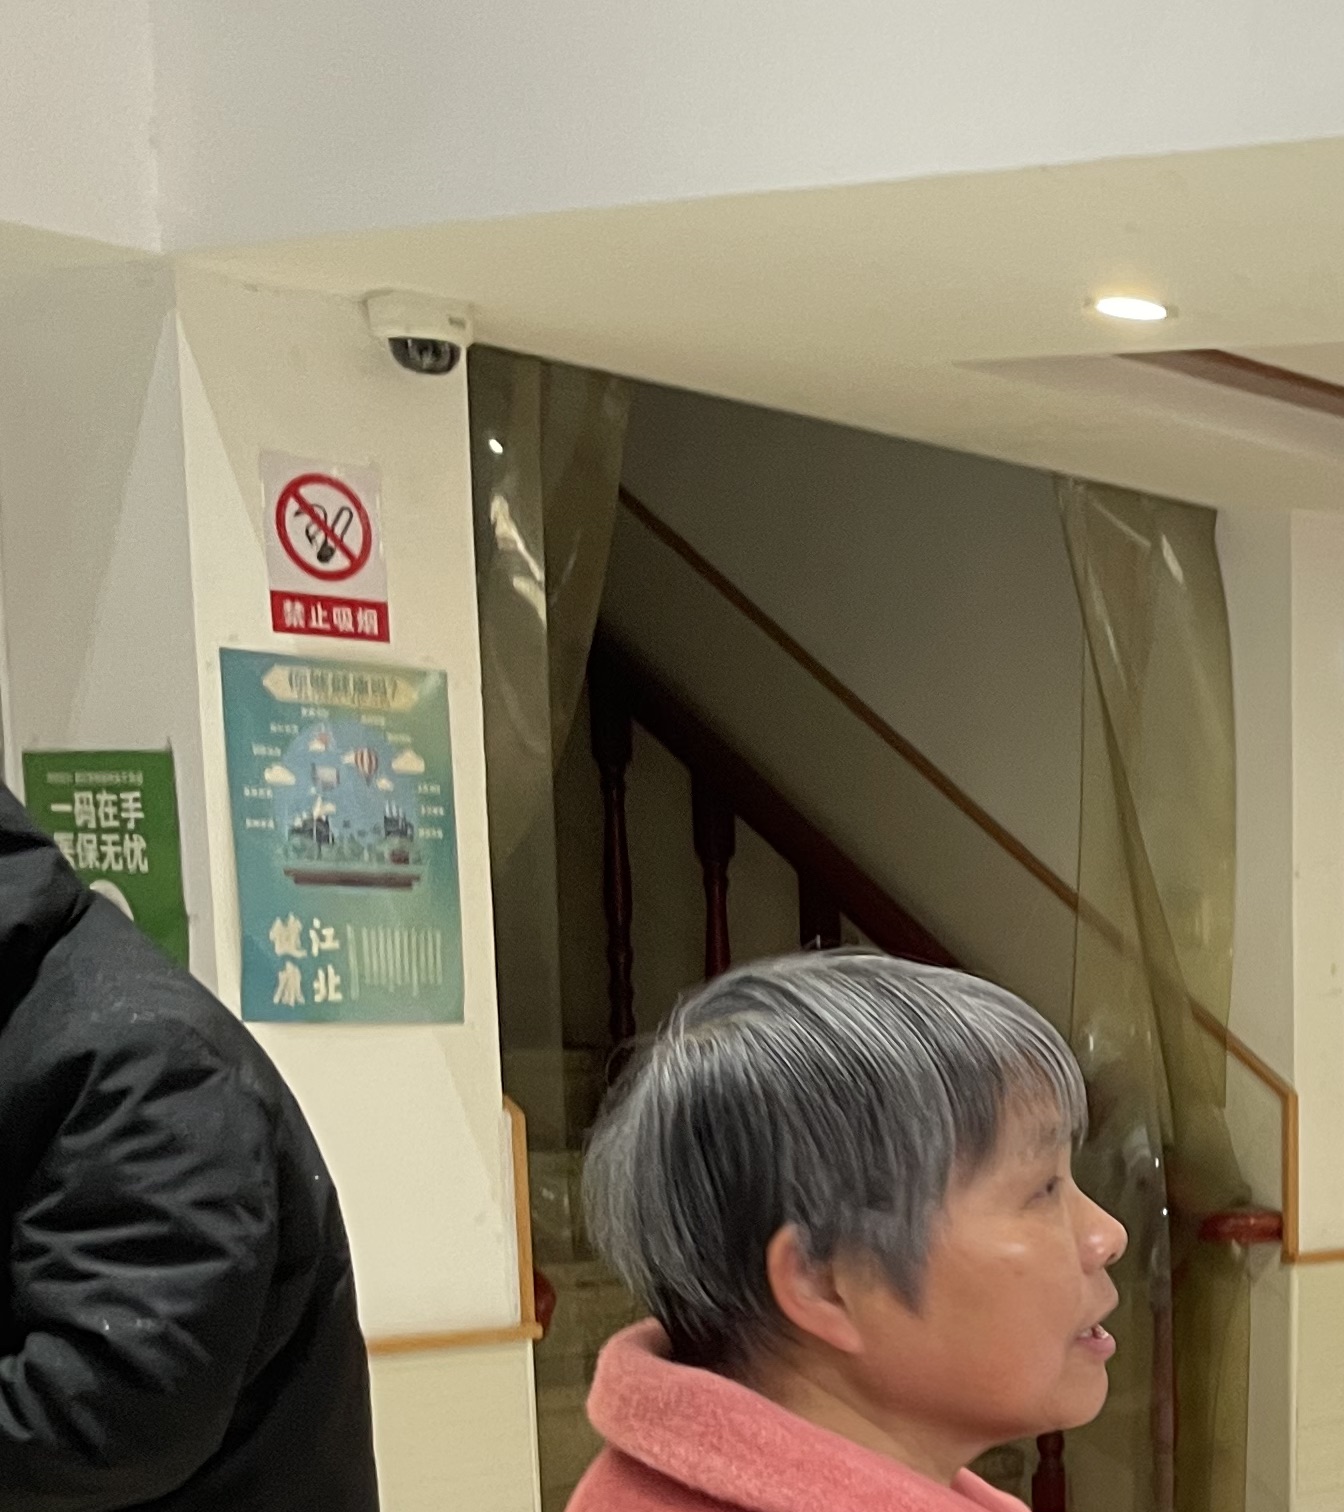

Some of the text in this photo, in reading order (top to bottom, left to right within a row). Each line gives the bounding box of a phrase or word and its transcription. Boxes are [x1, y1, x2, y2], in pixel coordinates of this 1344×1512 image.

[283, 598, 379, 636] 禁止吸烟
[50, 788, 145, 830] 一码在手
